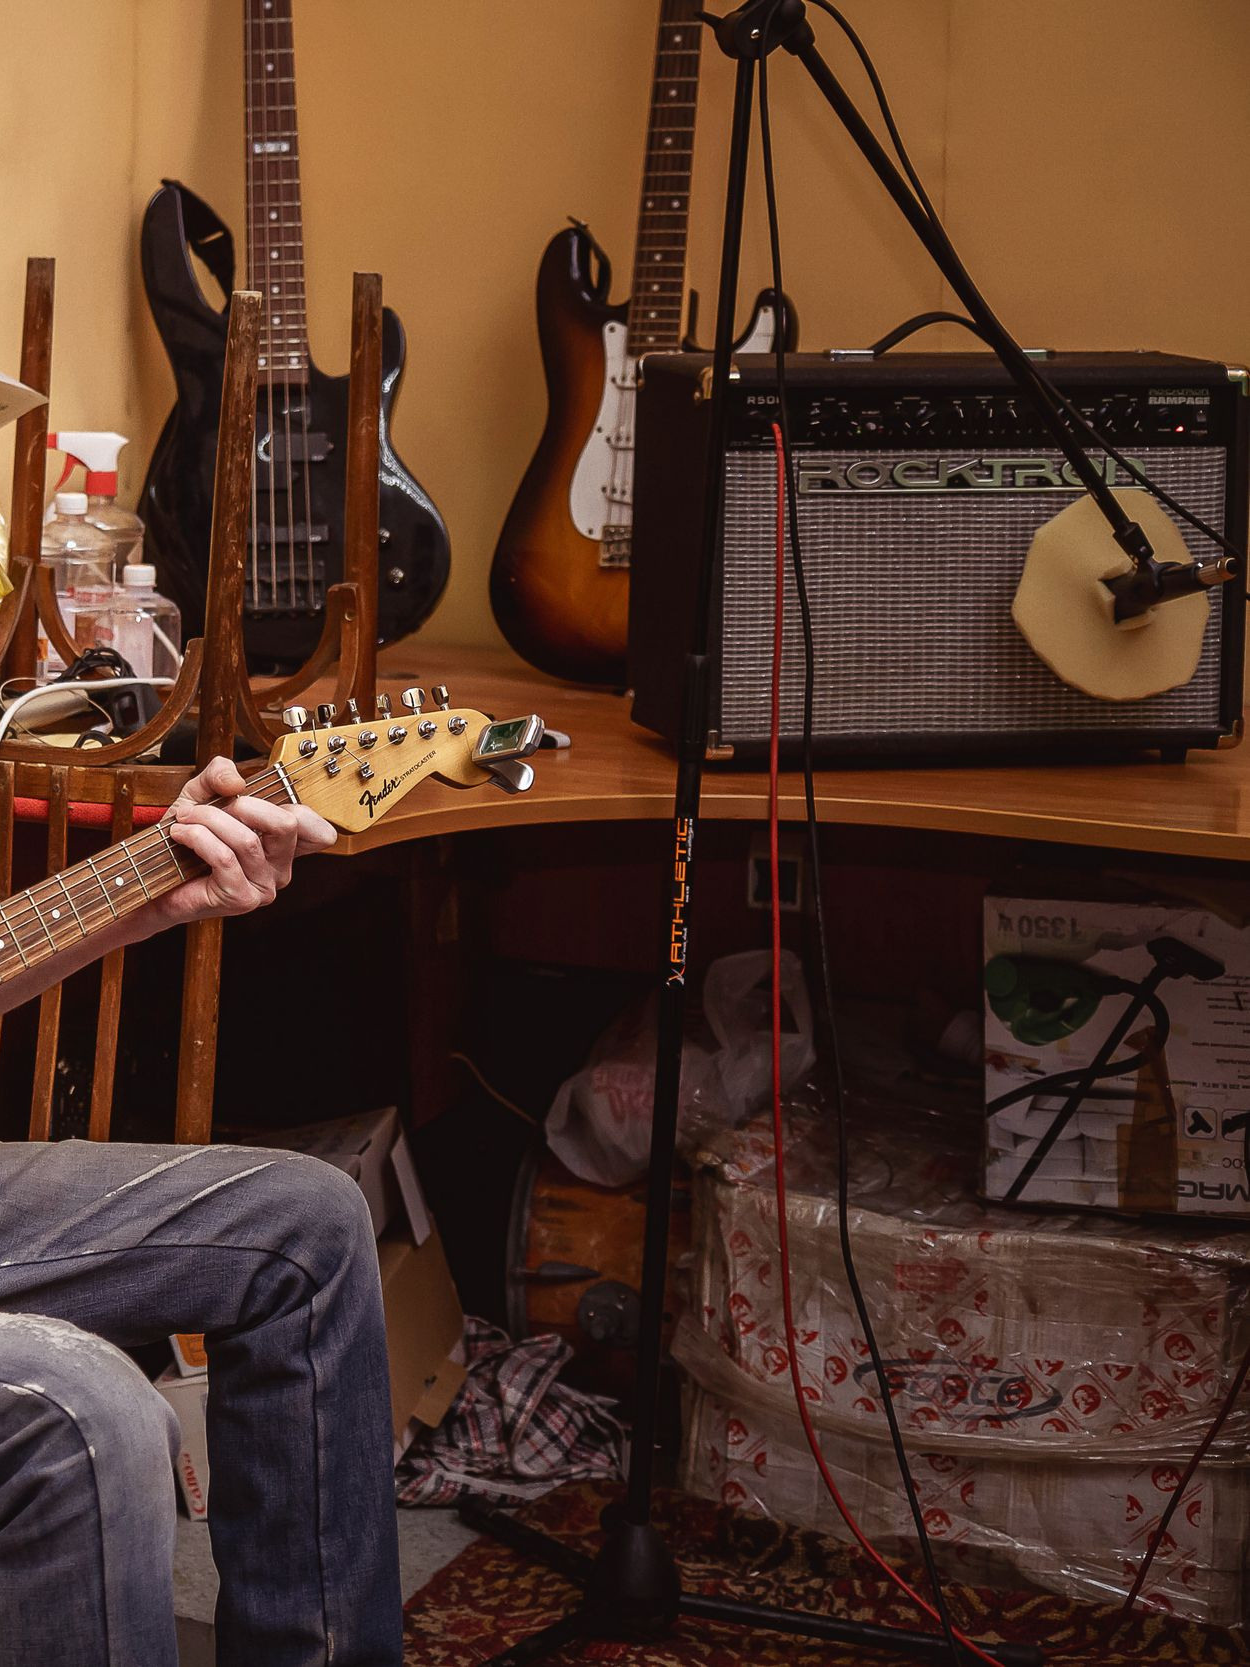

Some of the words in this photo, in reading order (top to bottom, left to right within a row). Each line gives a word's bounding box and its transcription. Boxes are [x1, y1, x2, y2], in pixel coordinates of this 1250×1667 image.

[1148, 396, 1210, 404] RAMPAGE
[359, 778, 402, 818] Fender
[400, 750, 437, 781] STRATOCASTER
[1018, 915, 1081, 938] 1350
